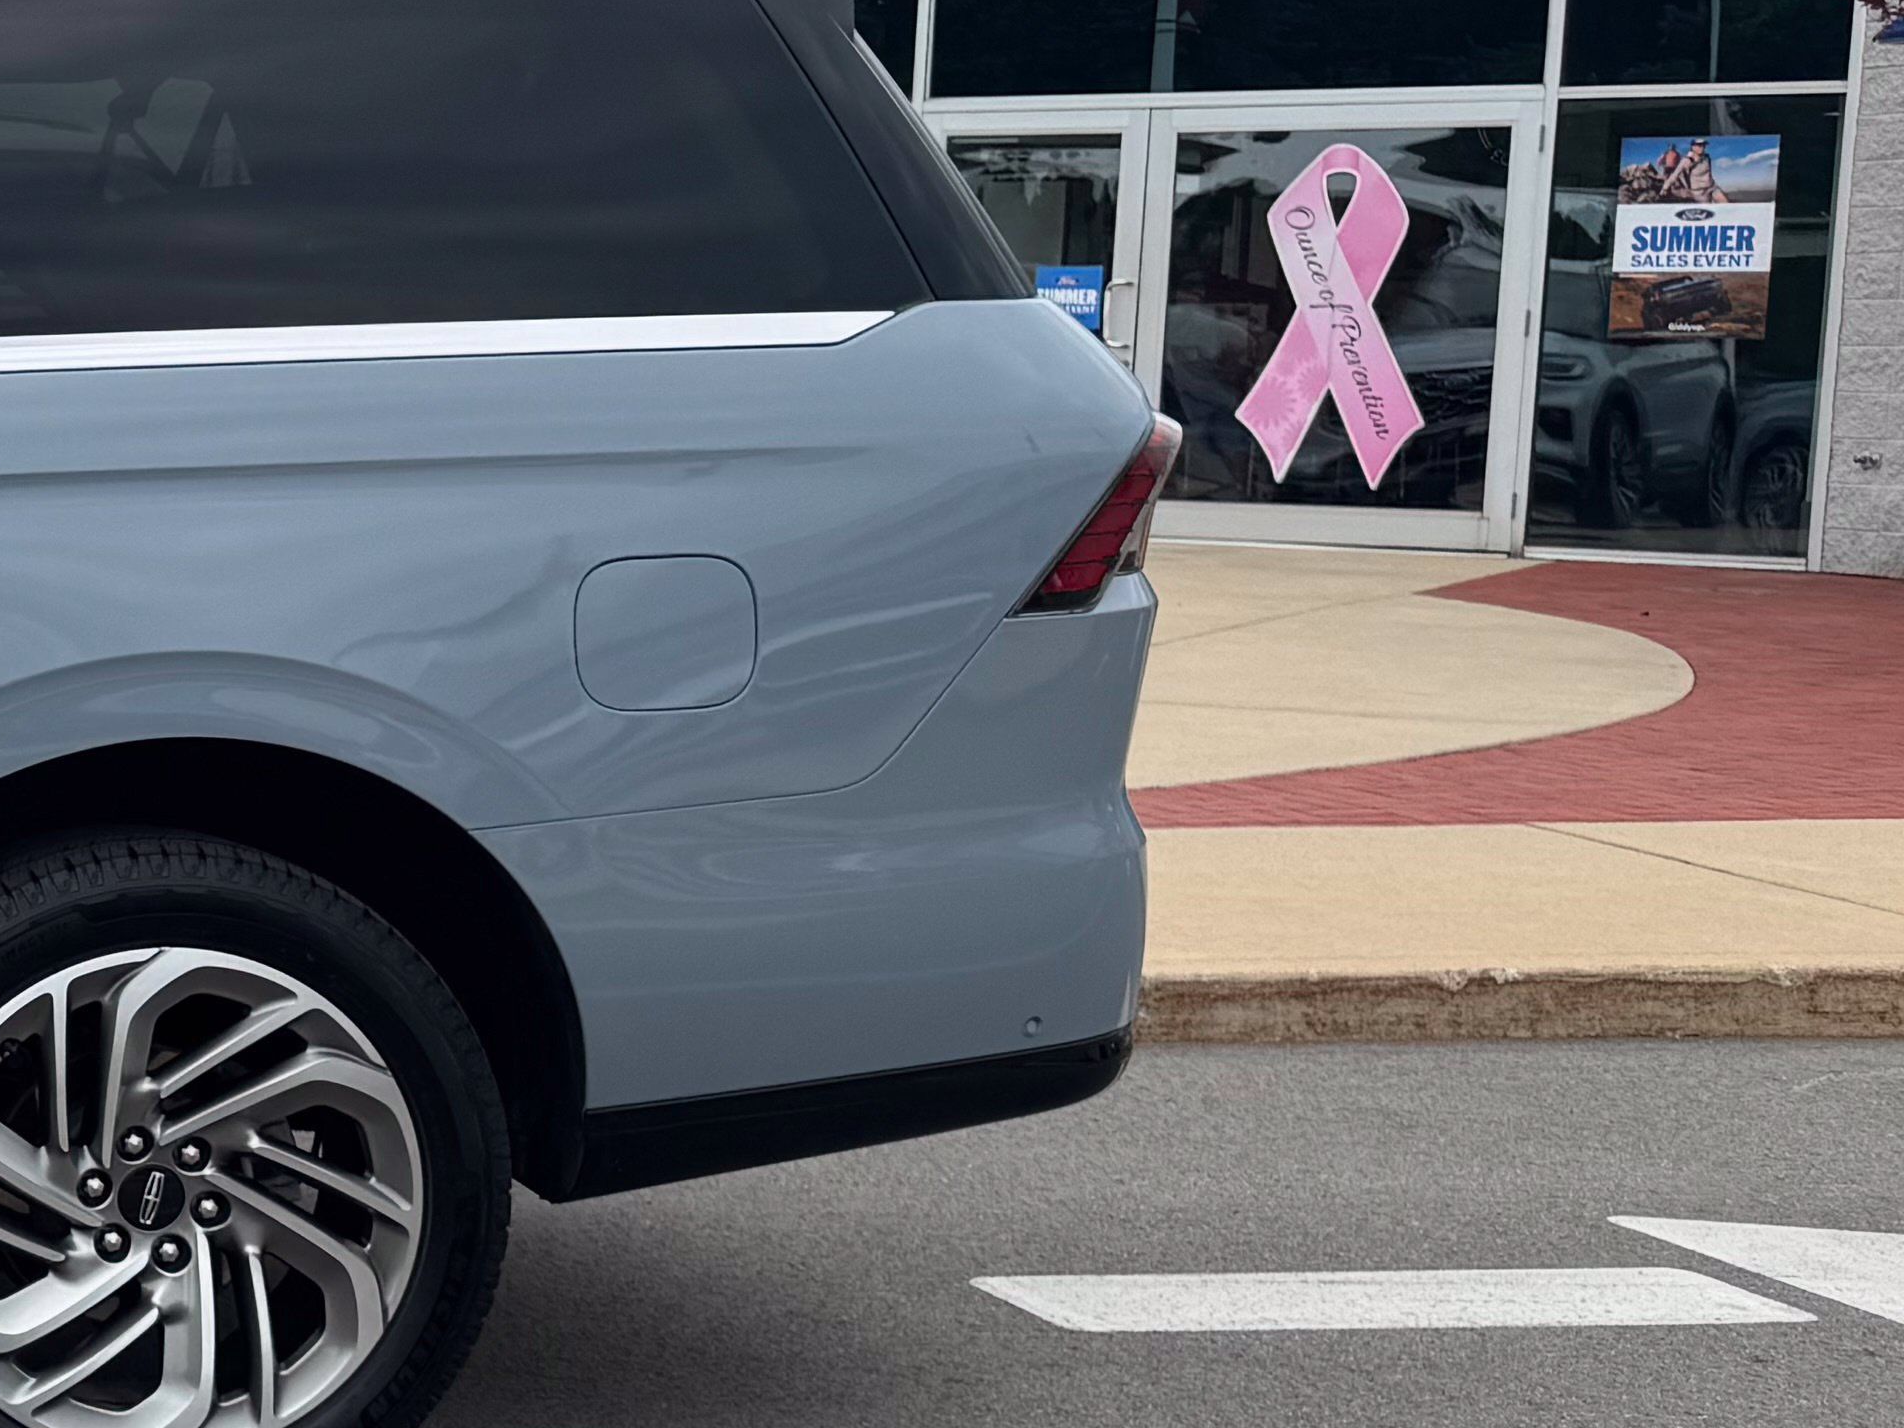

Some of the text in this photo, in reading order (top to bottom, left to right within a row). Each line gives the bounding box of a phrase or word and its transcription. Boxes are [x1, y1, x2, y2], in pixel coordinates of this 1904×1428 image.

[1631, 224, 1756, 253] SUMMER
[1630, 253, 1754, 268] SALES EVENT
[1285, 206, 1390, 441] Ounce of Prevention
